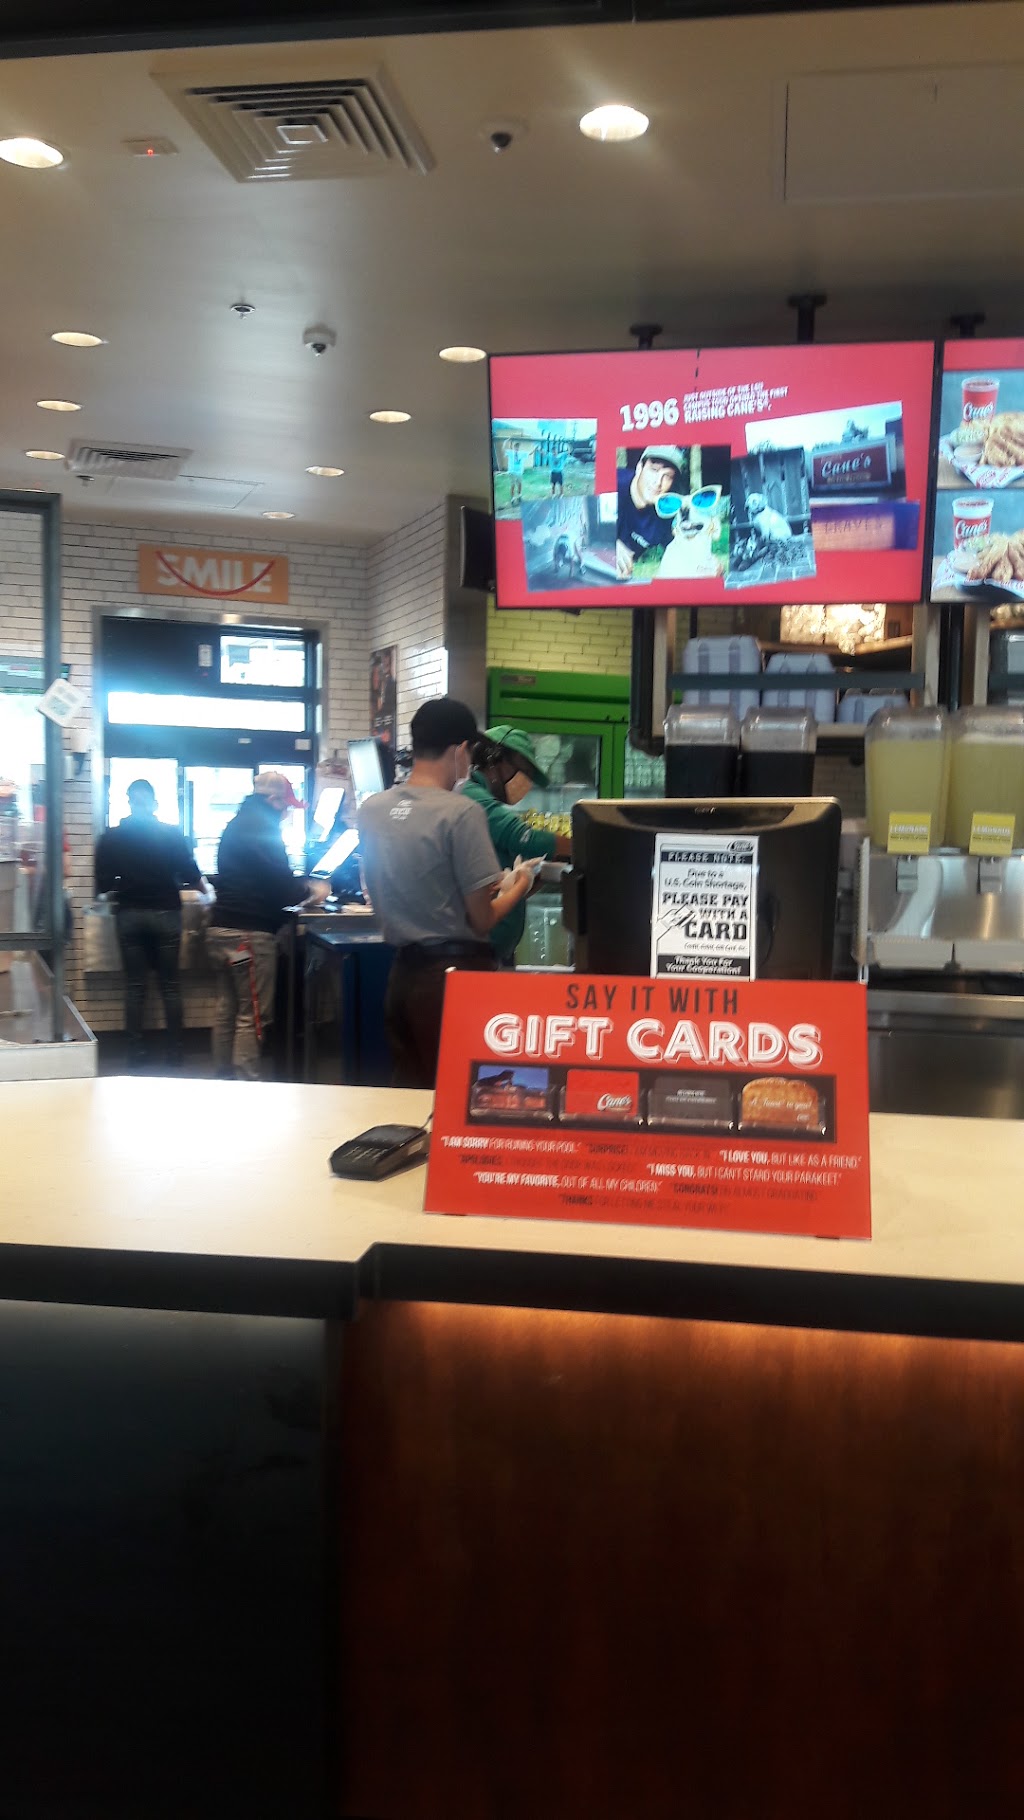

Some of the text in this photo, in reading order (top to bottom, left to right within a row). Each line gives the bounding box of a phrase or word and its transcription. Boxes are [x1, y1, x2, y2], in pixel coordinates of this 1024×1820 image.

[619, 398, 680, 432] 1996
[684, 405, 727, 423] RAISING
[822, 453, 872, 478] Cane's
[158, 553, 272, 593] SMILE
[668, 851, 746, 864] PLEASE NOTE:
[688, 868, 706, 878] Due
[682, 877, 703, 889] Coin
[662, 891, 749, 907] PLEASE PAY
[698, 907, 748, 920] WITH A
[684, 920, 748, 940] CARD
[566, 983, 739, 1016] SAY IT WITH
[484, 1013, 824, 1069] GIFT CARDS
[463, 1136, 490, 1149] SORRY
[728, 1149, 750, 1164] LOVE
[751, 1151, 770, 1165] YOU,
[771, 1152, 787, 1166] BUT
[788, 1152, 807, 1167] LIKE
[807, 1154, 820, 1167] AS
[655, 1163, 676, 1177] MISS
[677, 1164, 696, 1179] YOU,
[697, 1165, 714, 1179] BUT
[718, 1167, 741, 1180] CAN'T
[742, 1168, 770, 1182] STAND
[771, 1169, 793, 1183] YOUR
[561, 1174, 577, 1189] OUT
[577, 1176, 589, 1189] OF
[590, 1177, 605, 1191] ALL
[605, 1178, 619, 1191] MY
